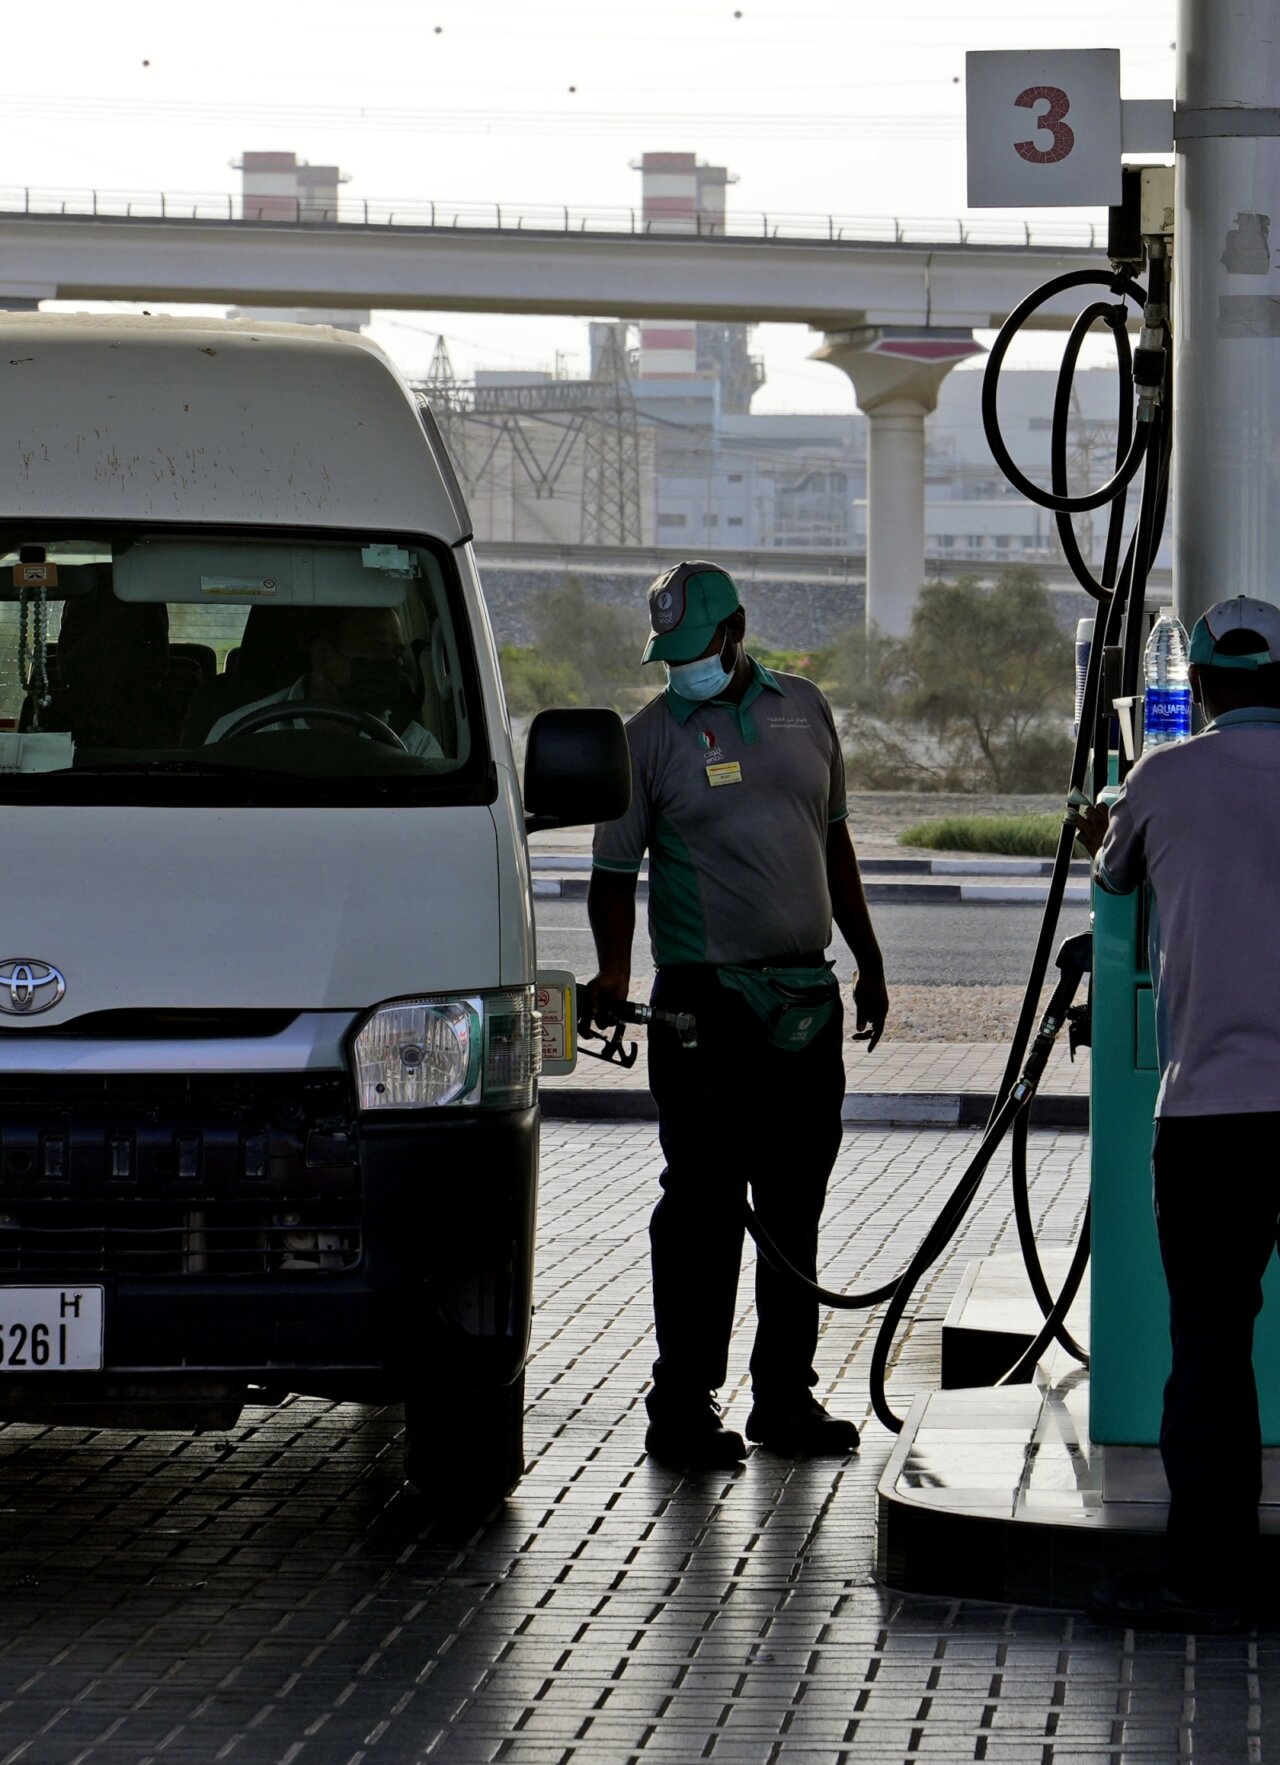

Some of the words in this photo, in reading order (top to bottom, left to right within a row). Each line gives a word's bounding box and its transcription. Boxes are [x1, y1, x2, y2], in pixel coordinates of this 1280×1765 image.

[1013, 86, 1075, 164] 3
[60, 1292, 80, 1318] H
[0, 1323, 67, 1366] 261
